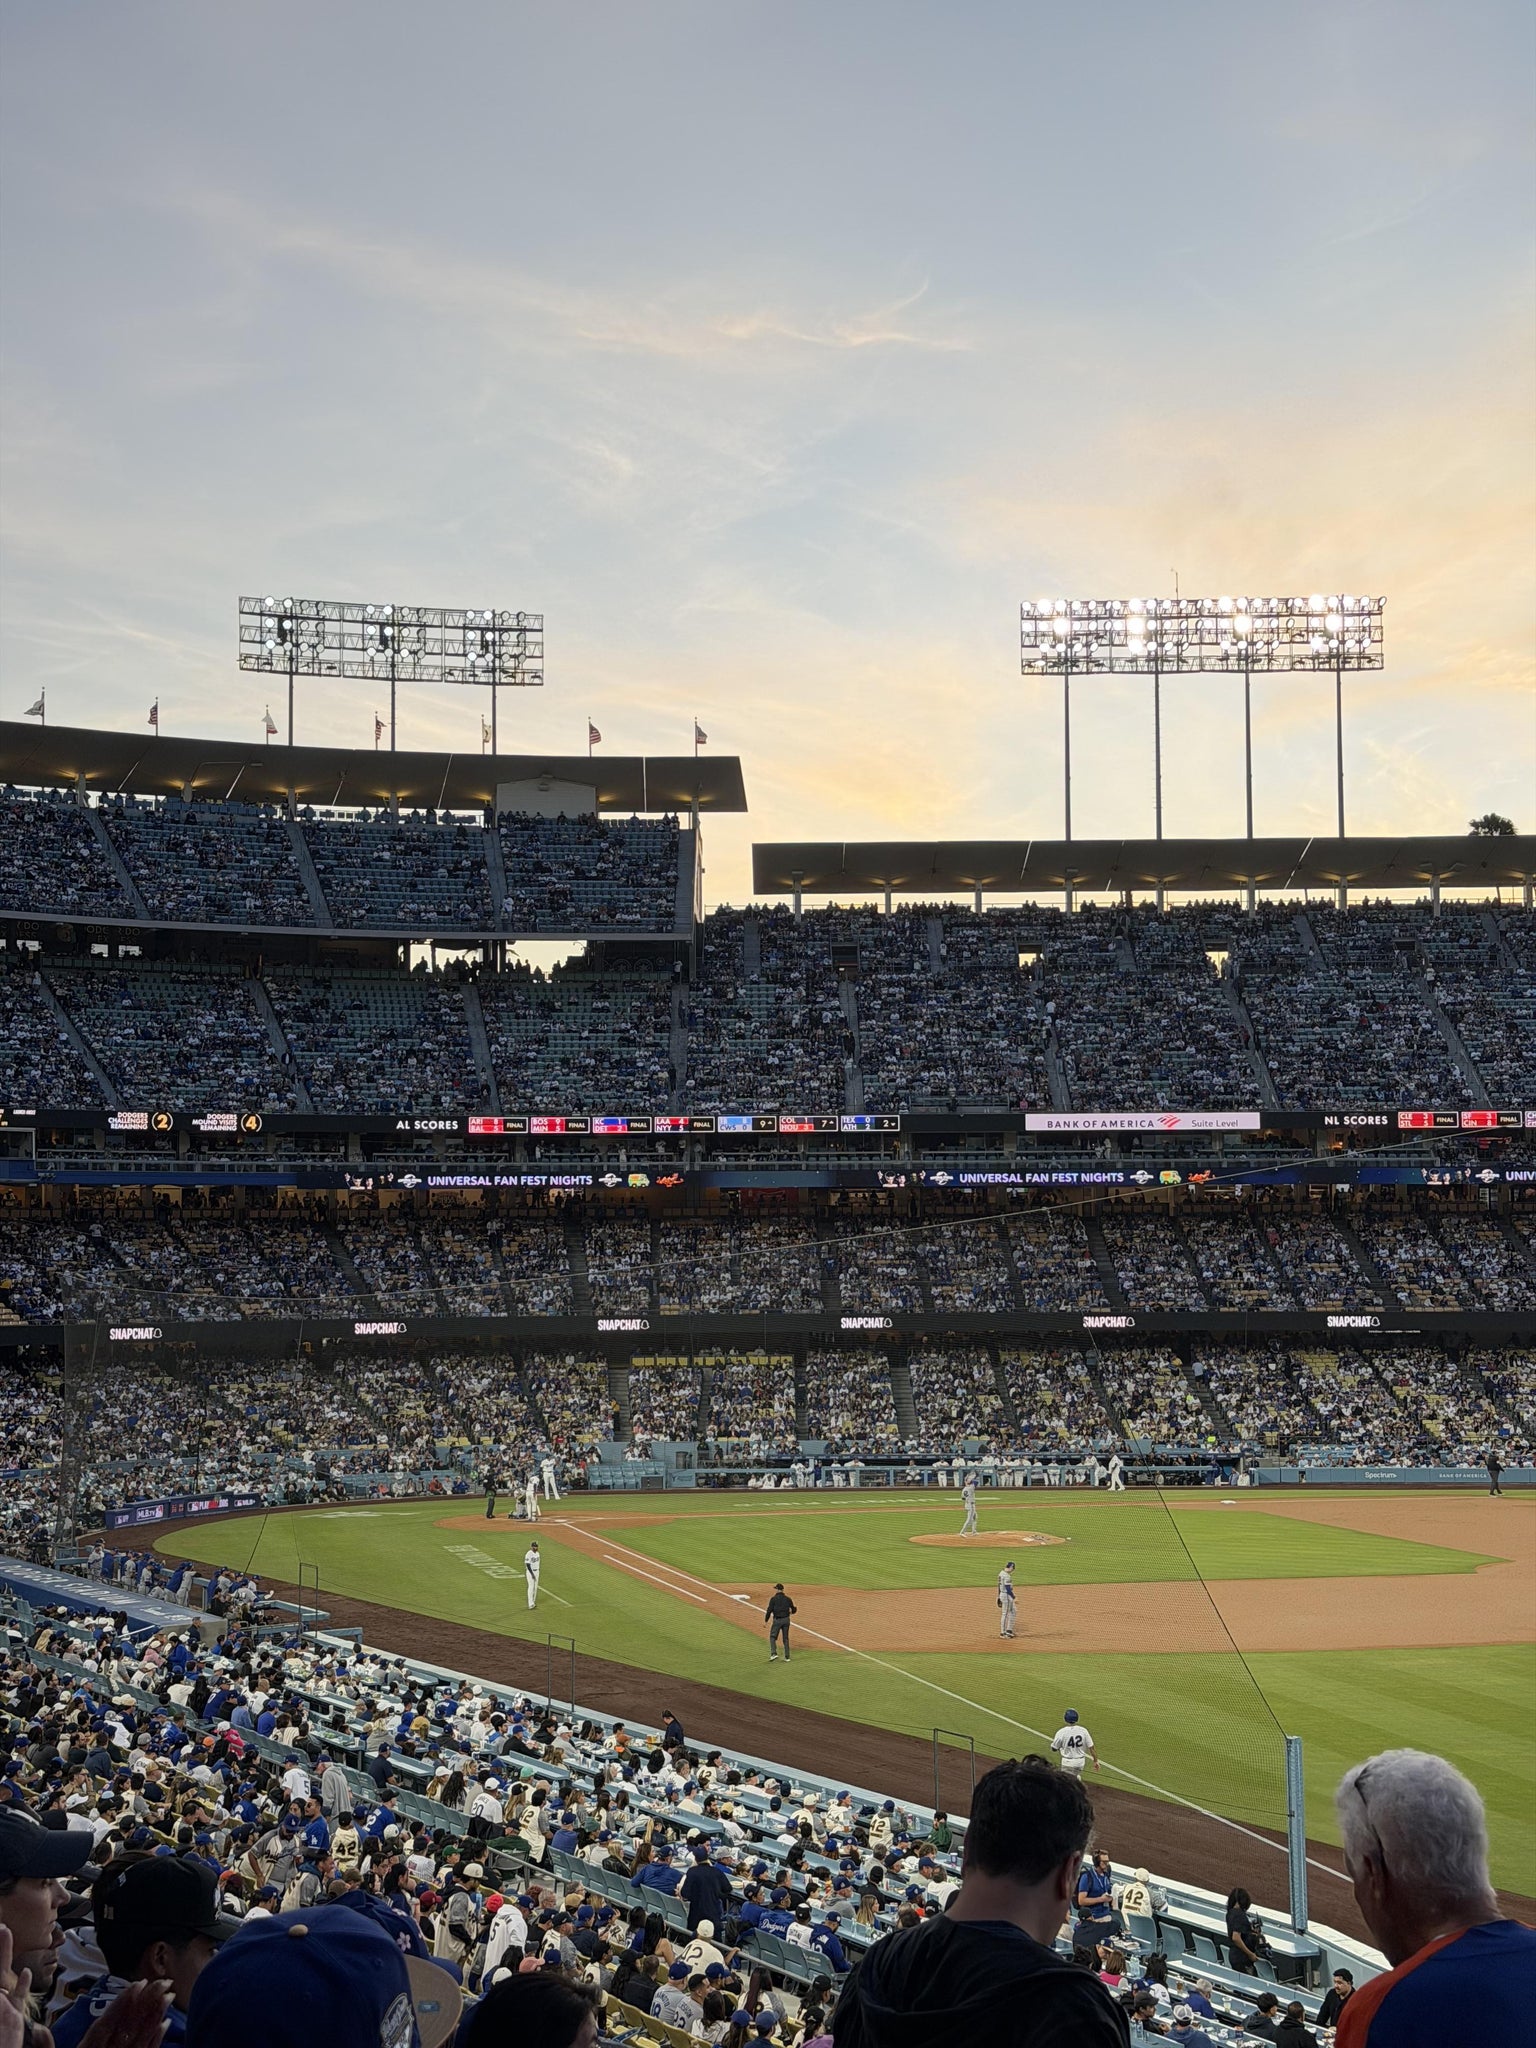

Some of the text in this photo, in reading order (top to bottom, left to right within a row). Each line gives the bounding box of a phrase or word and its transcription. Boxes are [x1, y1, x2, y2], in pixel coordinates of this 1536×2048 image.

[396, 1120, 458, 1129] AL SCORES
[759, 1120, 766, 1128] 9
[821, 1120, 827, 1128] 7
[1047, 1120, 1154, 1129] BANK OF AMERICA
[1192, 1119, 1238, 1128] Suite Level
[1325, 1115, 1388, 1125] NL SCORES
[1436, 1116, 1454, 1124] FINAL
[427, 1174, 593, 1187] UNIVERSAL FAN FEST NIGHTS
[959, 1172, 1023, 1184] UNIVERSAL
[1025, 1172, 1049, 1183] FAN
[1052, 1172, 1078, 1183] FEST
[1081, 1172, 1124, 1183] NIGHTS
[597, 1319, 641, 1331] SNAPCHAT
[841, 1317, 884, 1329] SNAPCHAT
[1083, 1316, 1126, 1328] SNAPCHAT
[1327, 1315, 1371, 1327] SNAPCHAT
[110, 1328, 154, 1340] SNAPCHAT
[354, 1322, 398, 1334] SNAPCHAT
[1067, 1735, 1083, 1748] 42
[302, 1780, 310, 1795] 5
[870, 1819, 886, 1833] 42
[334, 1841, 357, 1857] 42
[1125, 1889, 1144, 1906] 42
[490, 1922, 500, 1942] 5
[761, 1919, 786, 1933] Dodgers
